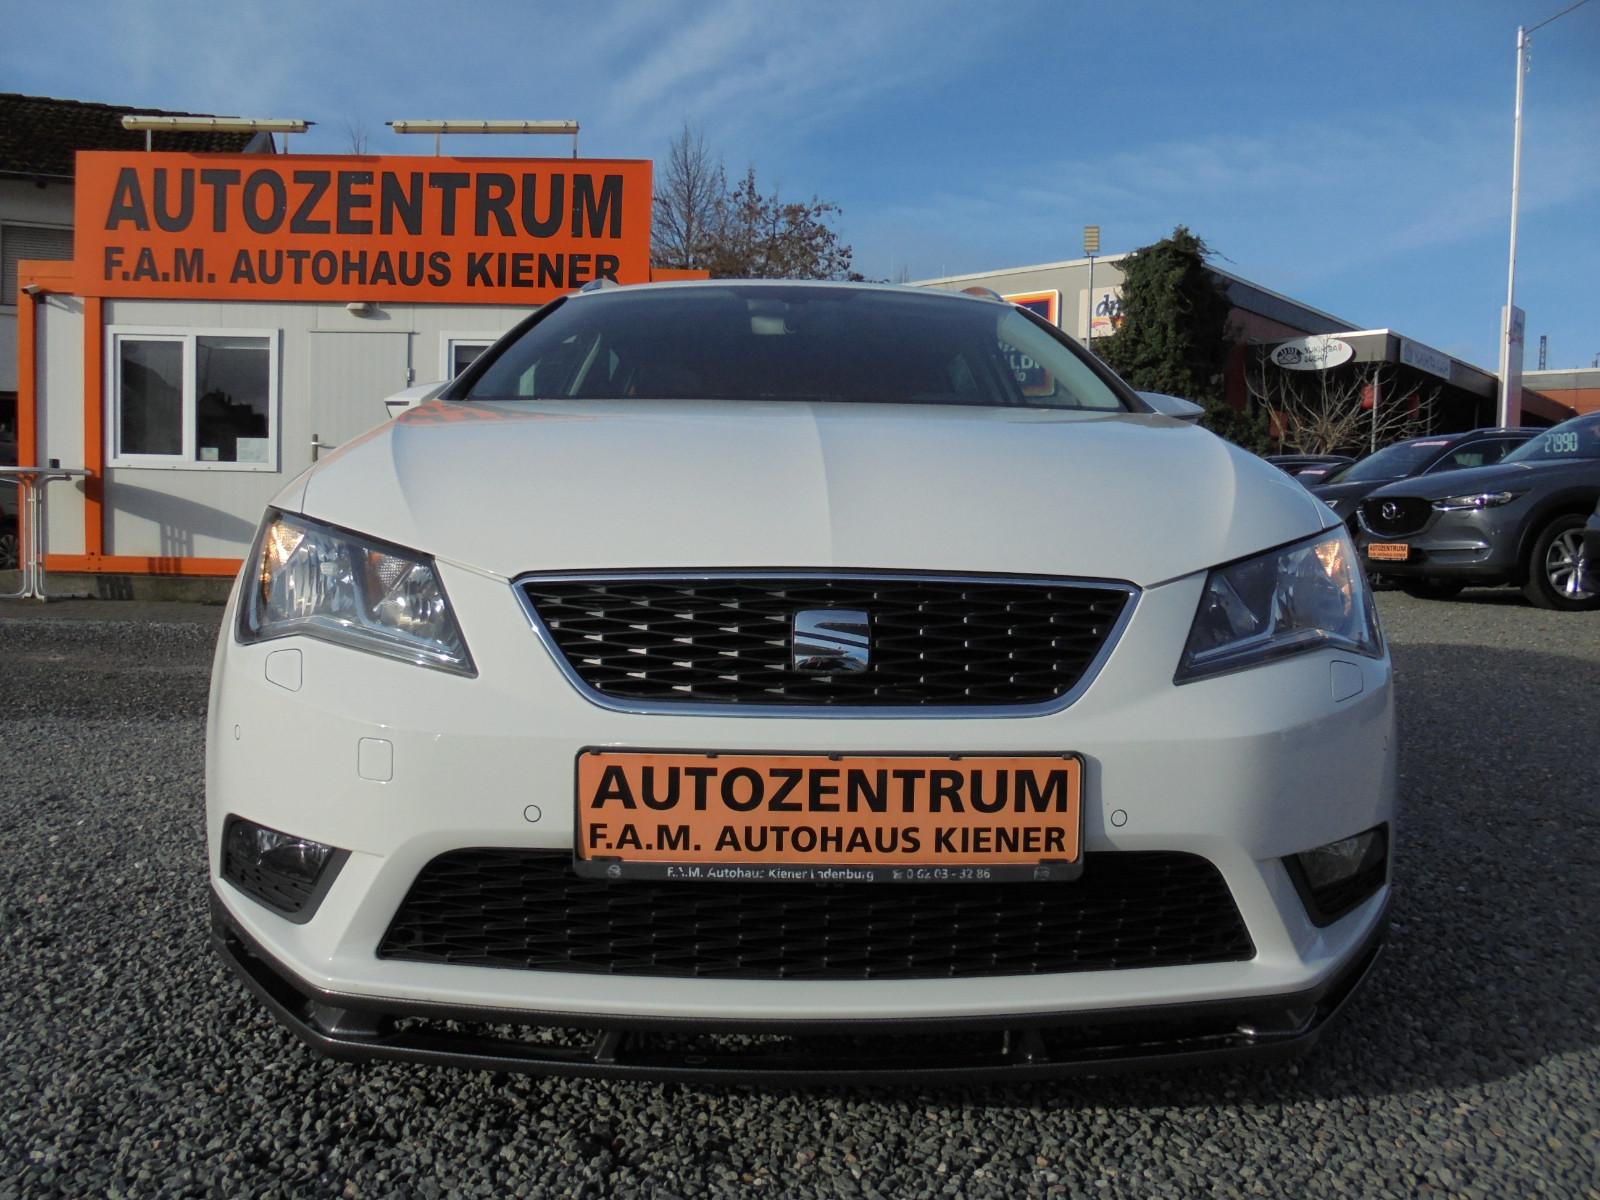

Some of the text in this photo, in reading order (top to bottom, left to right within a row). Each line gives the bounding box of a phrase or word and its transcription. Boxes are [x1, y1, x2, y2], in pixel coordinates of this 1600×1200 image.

[104, 167, 624, 239] AUTOZENTRUM
[104, 246, 620, 288] F.A.M. AUTOHAUS KIENER
[591, 765, 1068, 813] AUTOZENTRUM
[589, 823, 1066, 853] F.A.M. AUTOHAUS KIENER
[769, 867, 808, 879] Kiener
